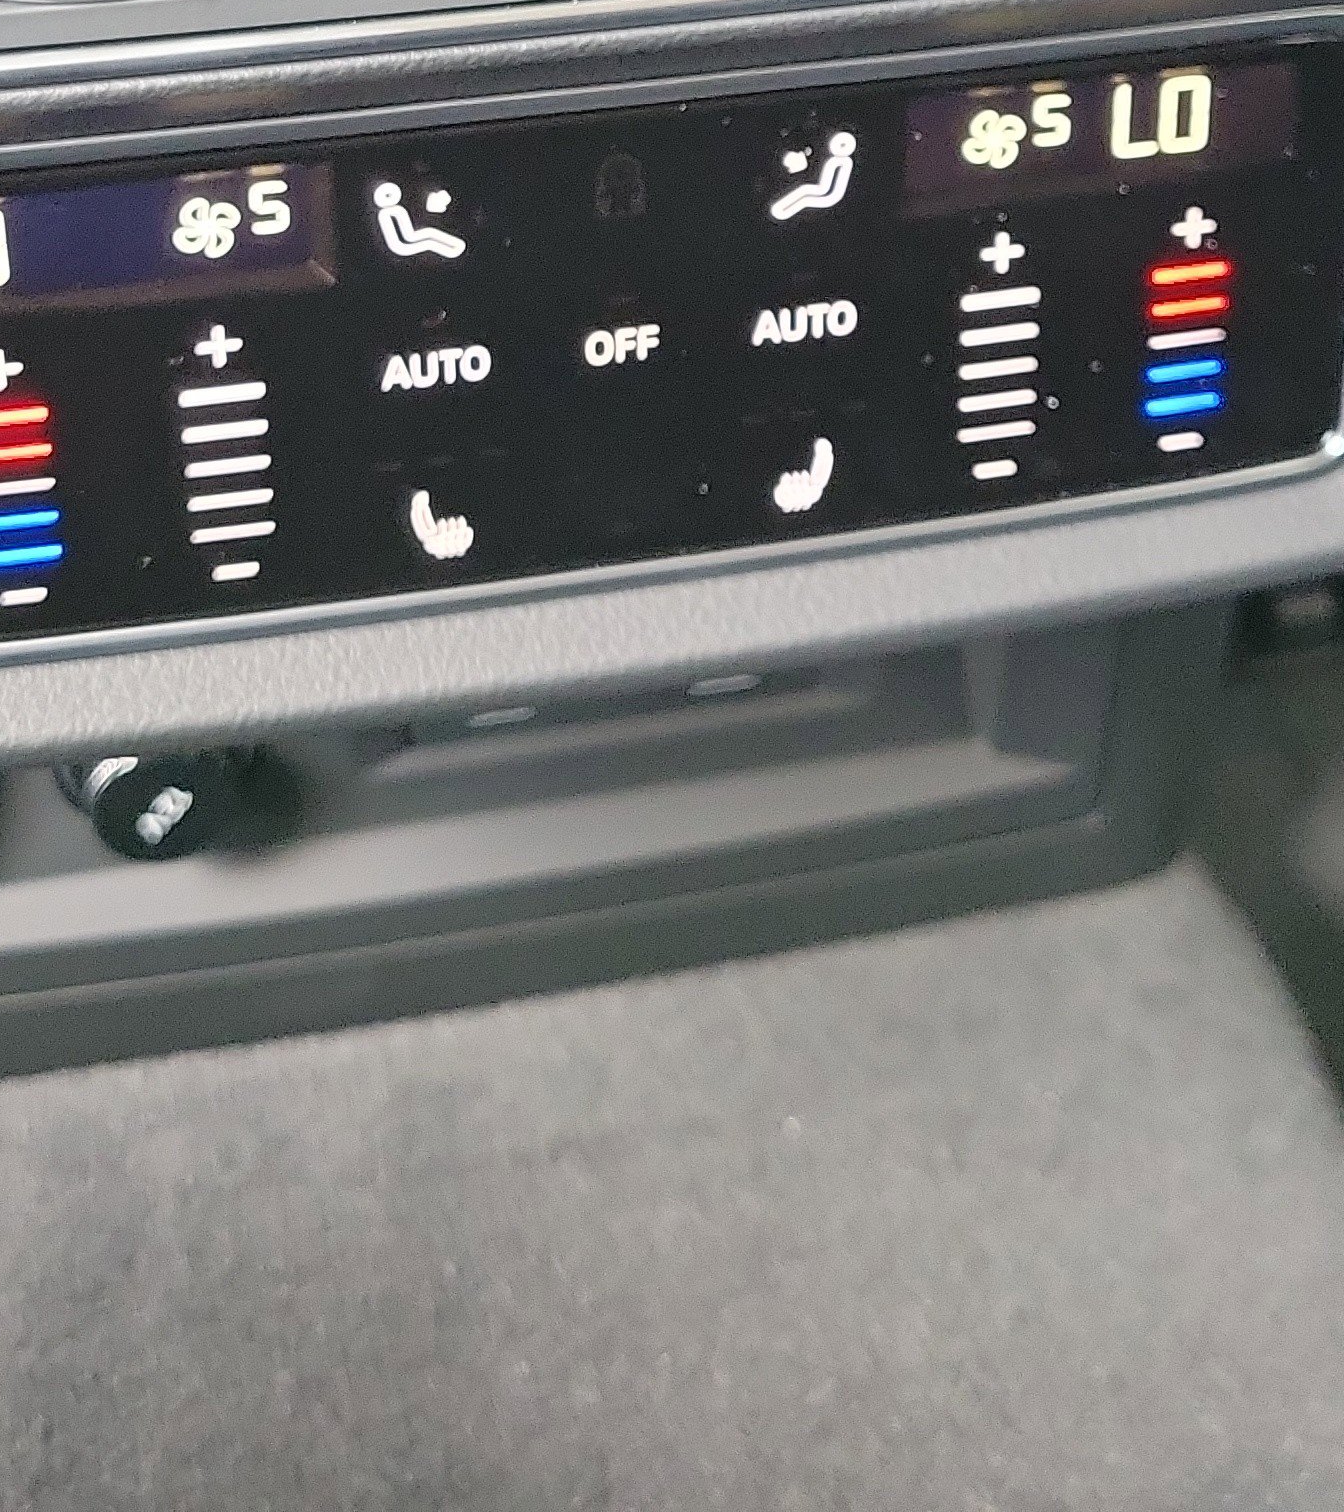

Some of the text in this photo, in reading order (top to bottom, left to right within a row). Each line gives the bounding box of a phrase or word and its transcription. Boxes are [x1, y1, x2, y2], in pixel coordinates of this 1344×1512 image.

[583, 323, 661, 367] OFF
[751, 299, 858, 347] AUTO
[380, 344, 492, 393] AUTO
